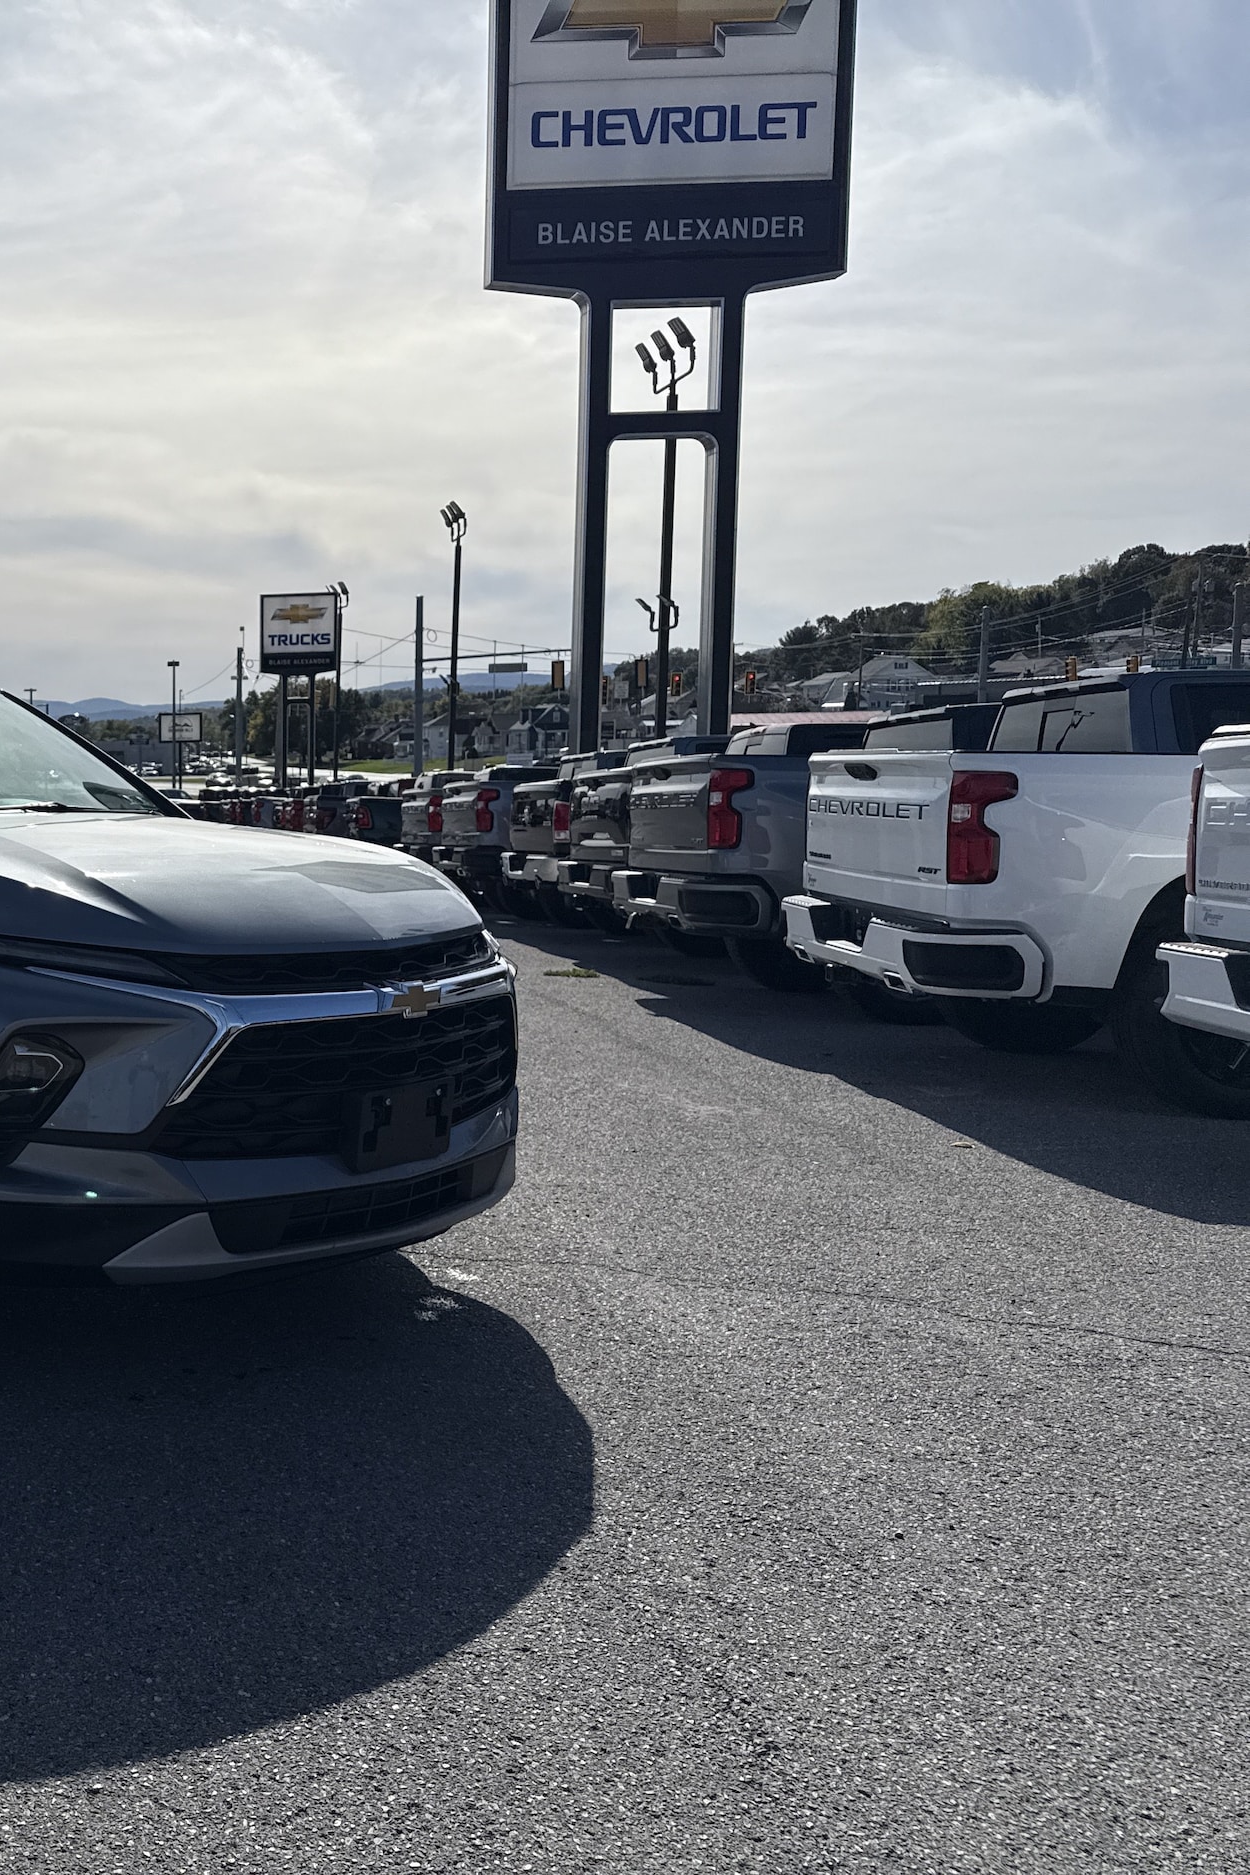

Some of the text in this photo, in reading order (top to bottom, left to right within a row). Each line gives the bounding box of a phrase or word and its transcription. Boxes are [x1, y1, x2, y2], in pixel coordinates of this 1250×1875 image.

[531, 101, 818, 148] CHEVROLET
[537, 215, 805, 246] BLAISE ALEXANDER
[268, 633, 331, 646] TRUCKS
[809, 798, 931, 820] CHEVROLET
[917, 866, 942, 875] RST
